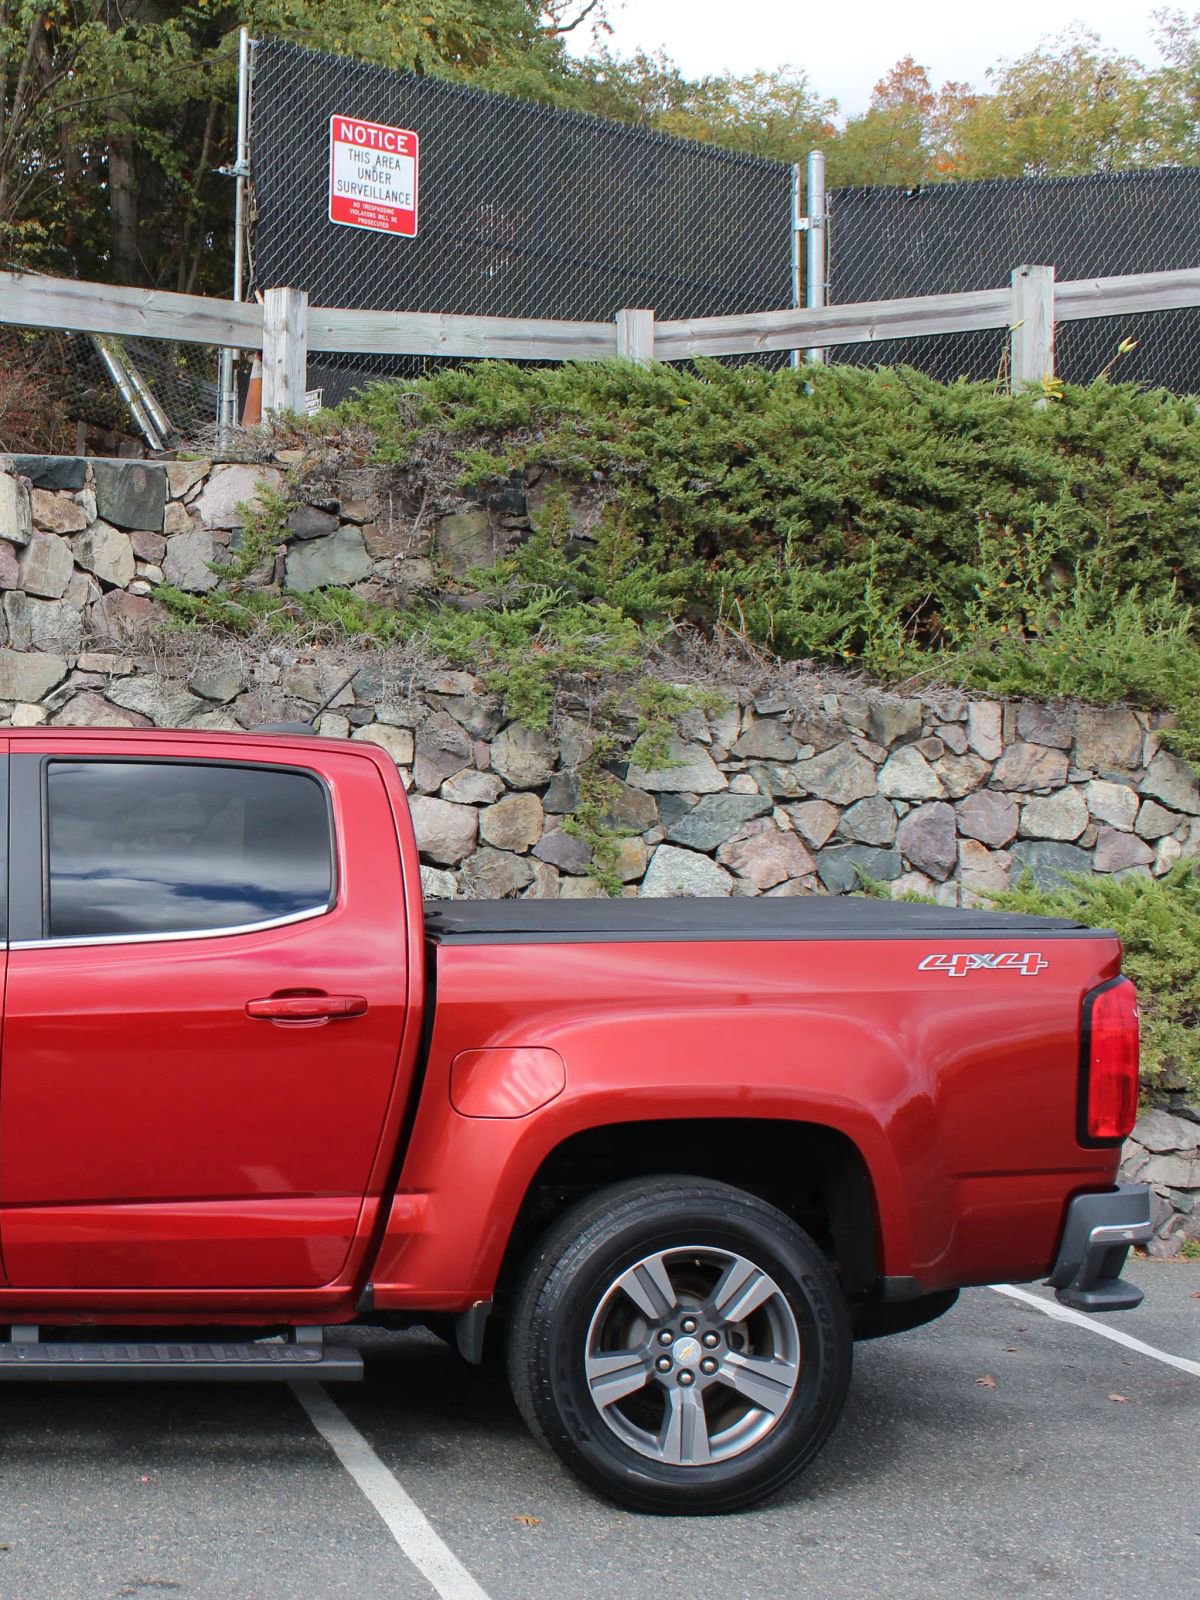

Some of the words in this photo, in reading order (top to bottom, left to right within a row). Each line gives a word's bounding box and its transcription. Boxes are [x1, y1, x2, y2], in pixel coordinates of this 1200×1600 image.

[341, 122, 408, 153] NOTICE
[348, 148, 370, 164] THIS
[375, 155, 401, 171] AREA
[357, 167, 391, 185] UNDER
[337, 179, 411, 206] SURVEILLANCE
[349, 208, 376, 219] VIOLATORS
[378, 212, 389, 221] WILL
[391, 215, 398, 223] BE
[363, 202, 395, 215] TRESPASSING
[357, 217, 390, 228] PROSECUTED
